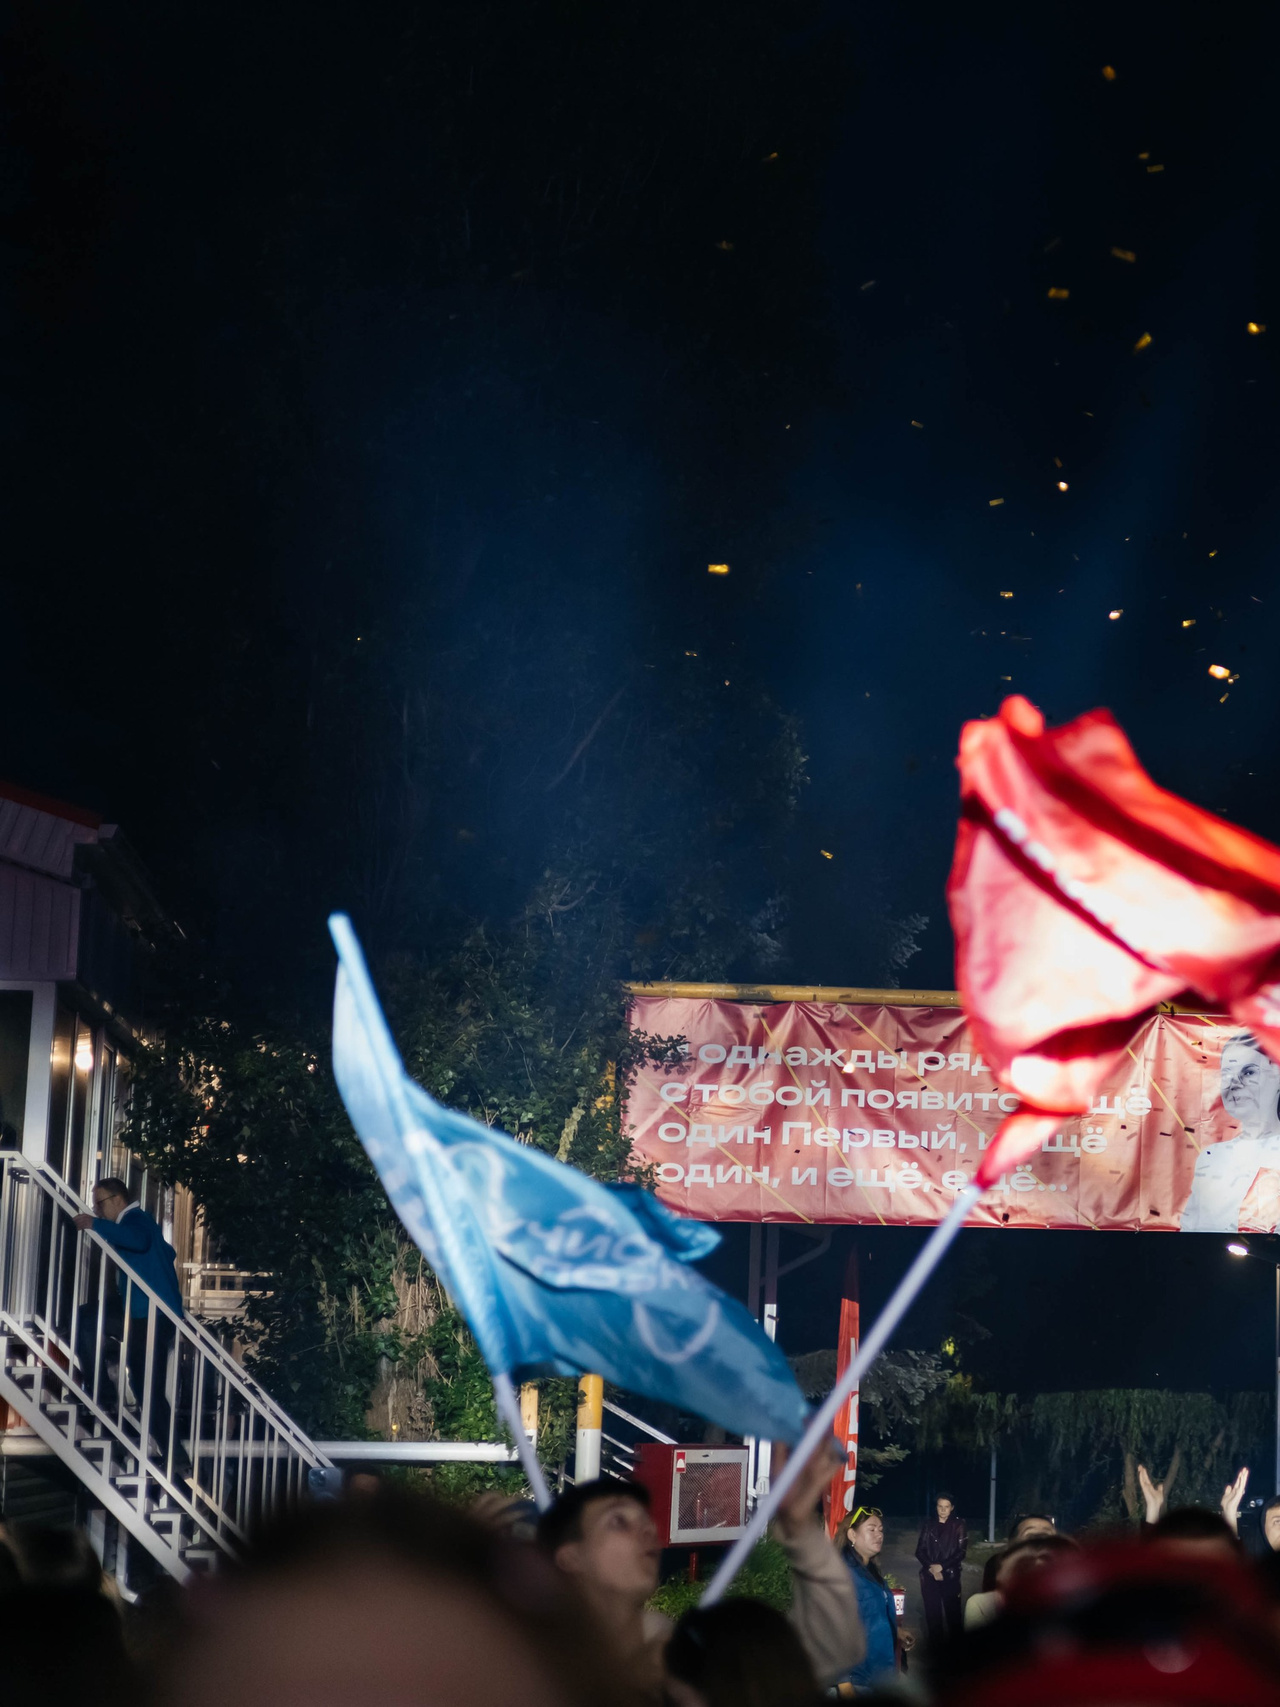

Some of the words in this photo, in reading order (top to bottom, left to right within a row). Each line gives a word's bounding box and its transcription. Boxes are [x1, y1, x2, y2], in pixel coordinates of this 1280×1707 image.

[698, 1043, 908, 1074] однажды
[918, 1051, 992, 1077] ряд
[660, 1082, 688, 1103] с
[694, 1080, 831, 1106] тобой
[841, 1088, 1021, 1113] появитс
[1088, 1087, 1152, 1119] щё
[658, 1122, 771, 1148] один
[782, 1121, 967, 1154] Первый,
[1041, 1127, 1108, 1157] щё
[657, 1163, 780, 1188] один,
[791, 1166, 818, 1186] и
[827, 1161, 932, 1193] ещё,
